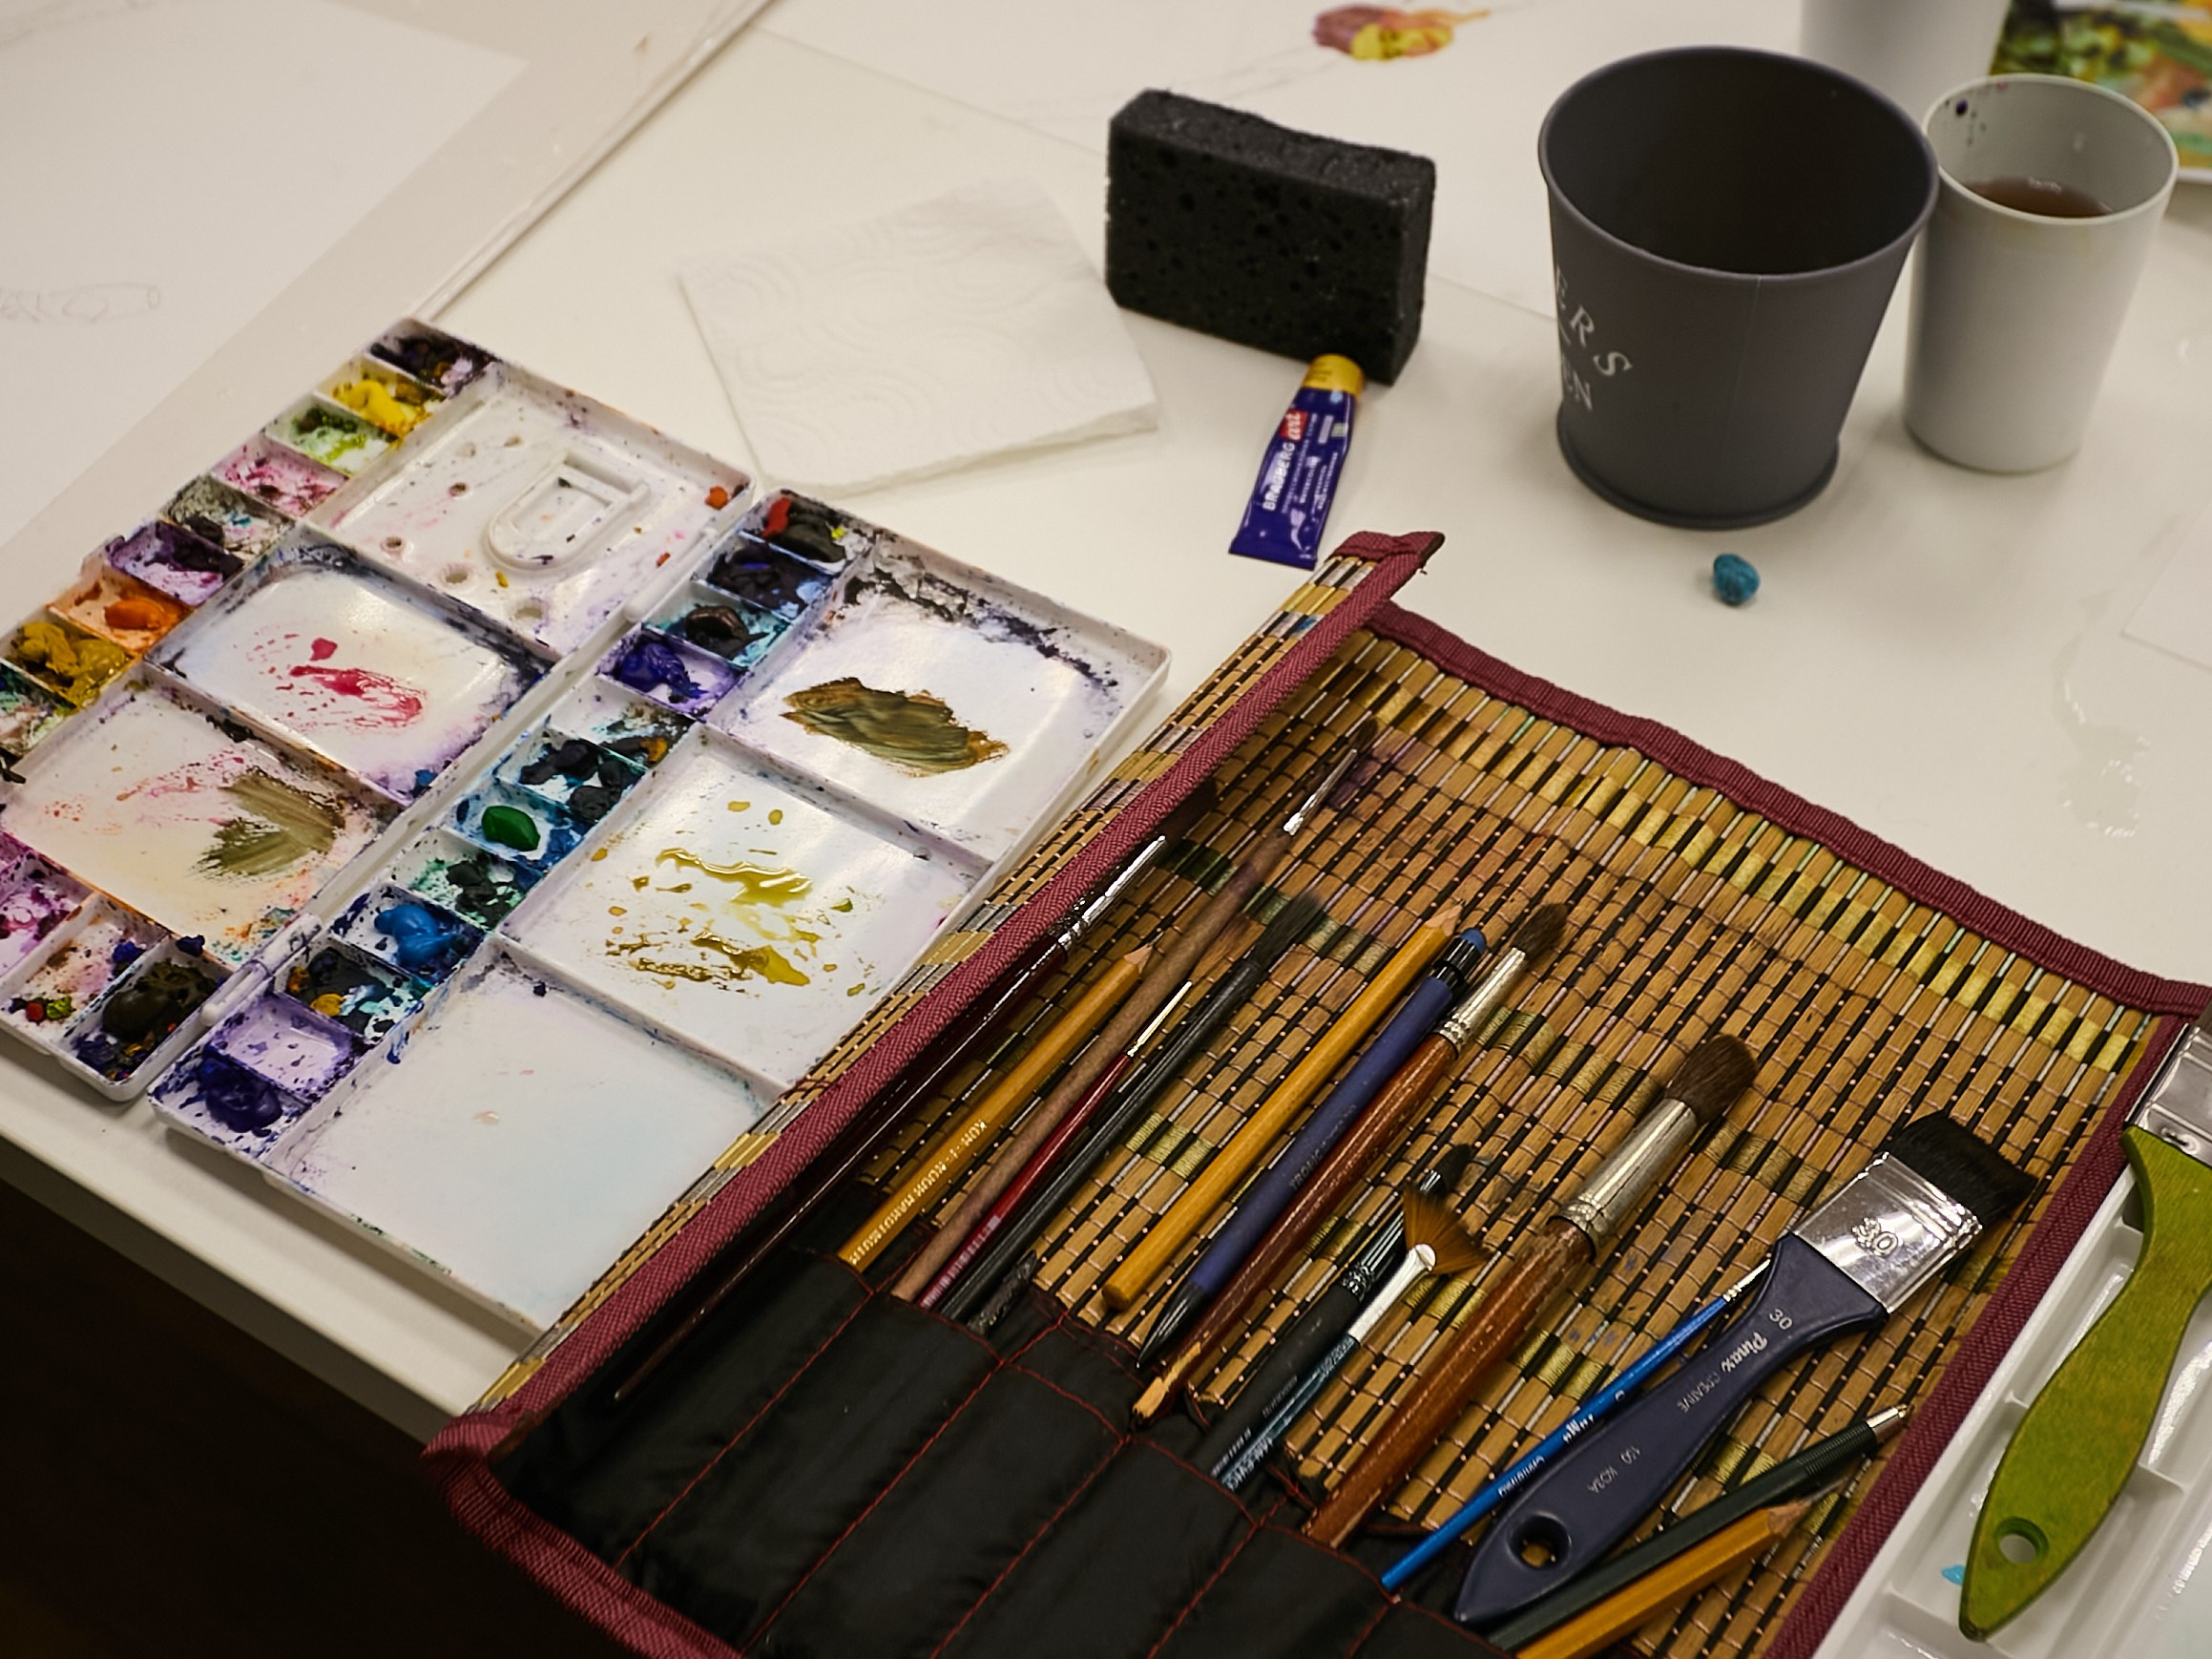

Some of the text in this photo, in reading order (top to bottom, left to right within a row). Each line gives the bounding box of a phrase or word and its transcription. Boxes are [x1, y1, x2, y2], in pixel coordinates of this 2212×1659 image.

[1851, 1217, 1899, 1256] 30
[1768, 1308, 1793, 1331] 30
[1677, 1331, 1768, 1414] Pinax CREATIVE
